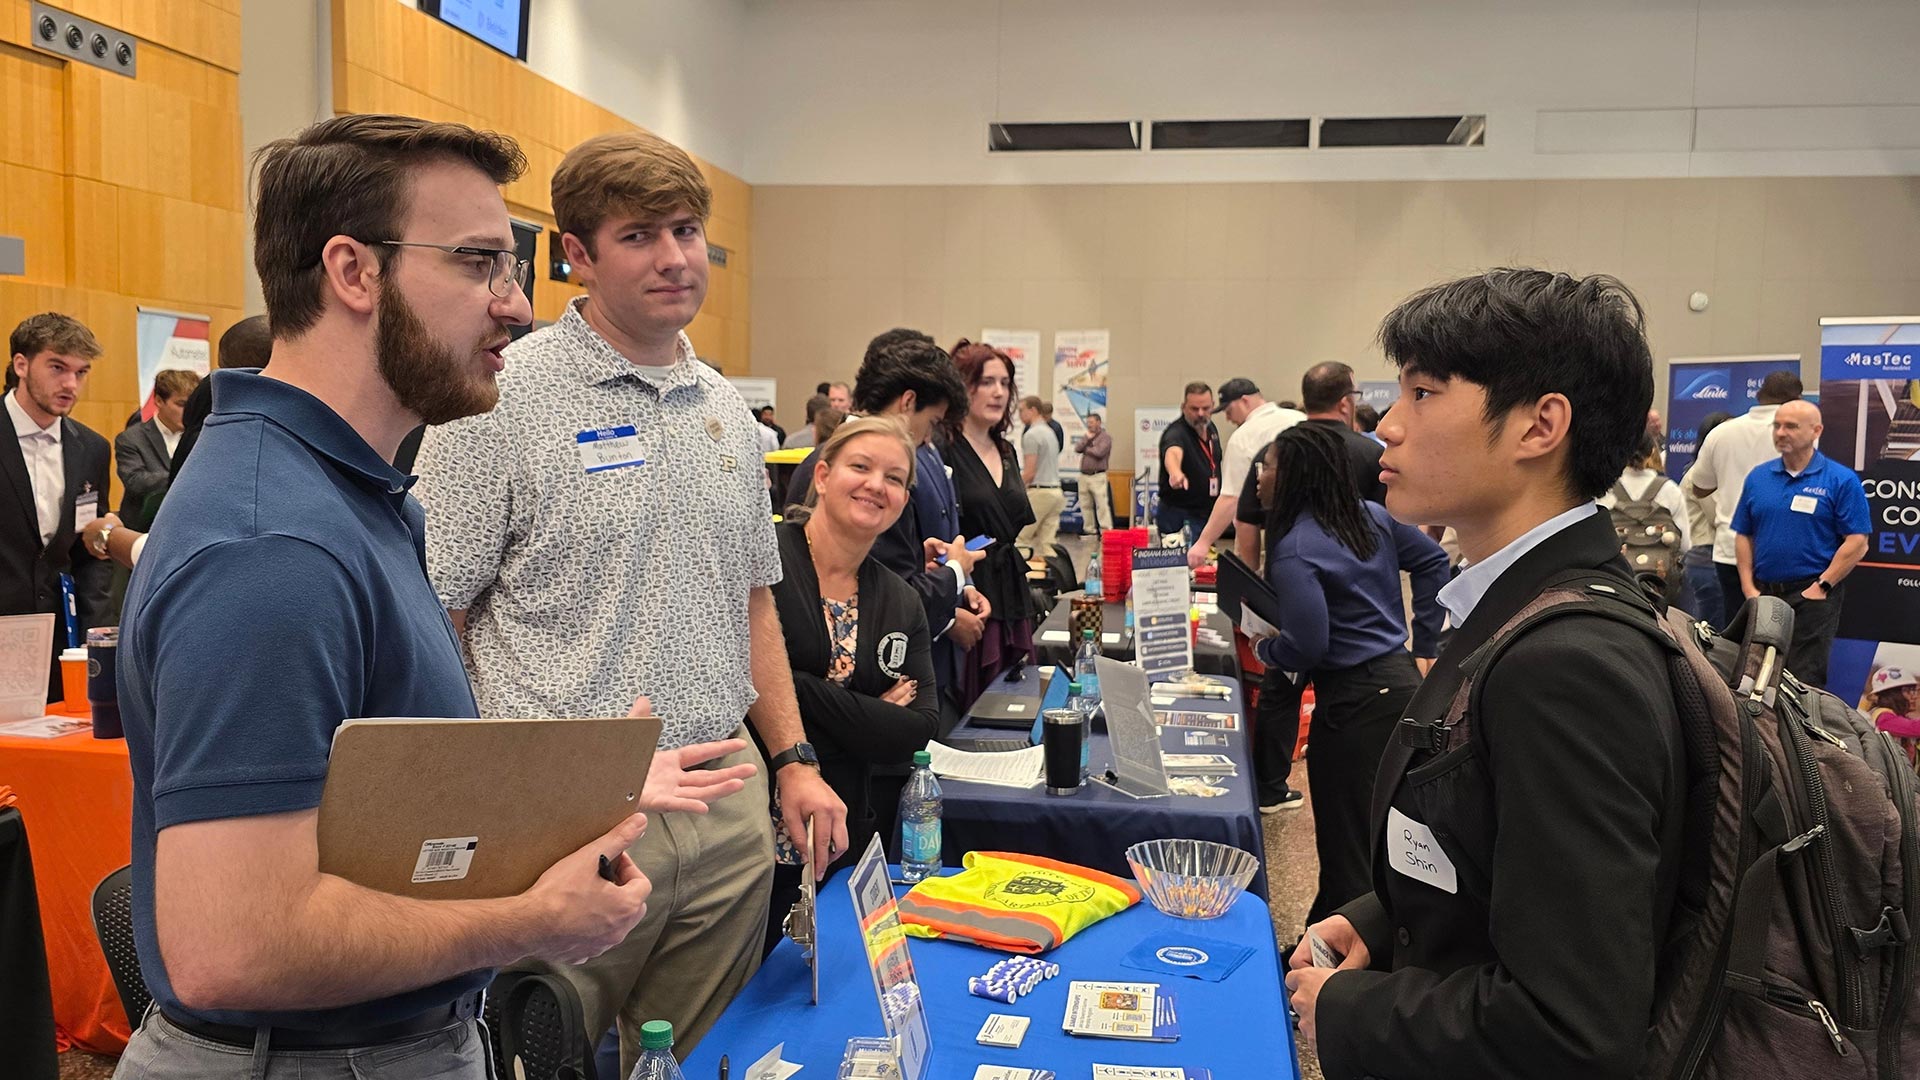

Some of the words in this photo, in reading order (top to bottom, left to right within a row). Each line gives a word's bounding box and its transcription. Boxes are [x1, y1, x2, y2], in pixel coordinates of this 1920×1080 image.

[1844, 351, 1912, 366] MasTec
[1403, 829, 1430, 852] Ryan
[1405, 851, 1437, 873] Shin
